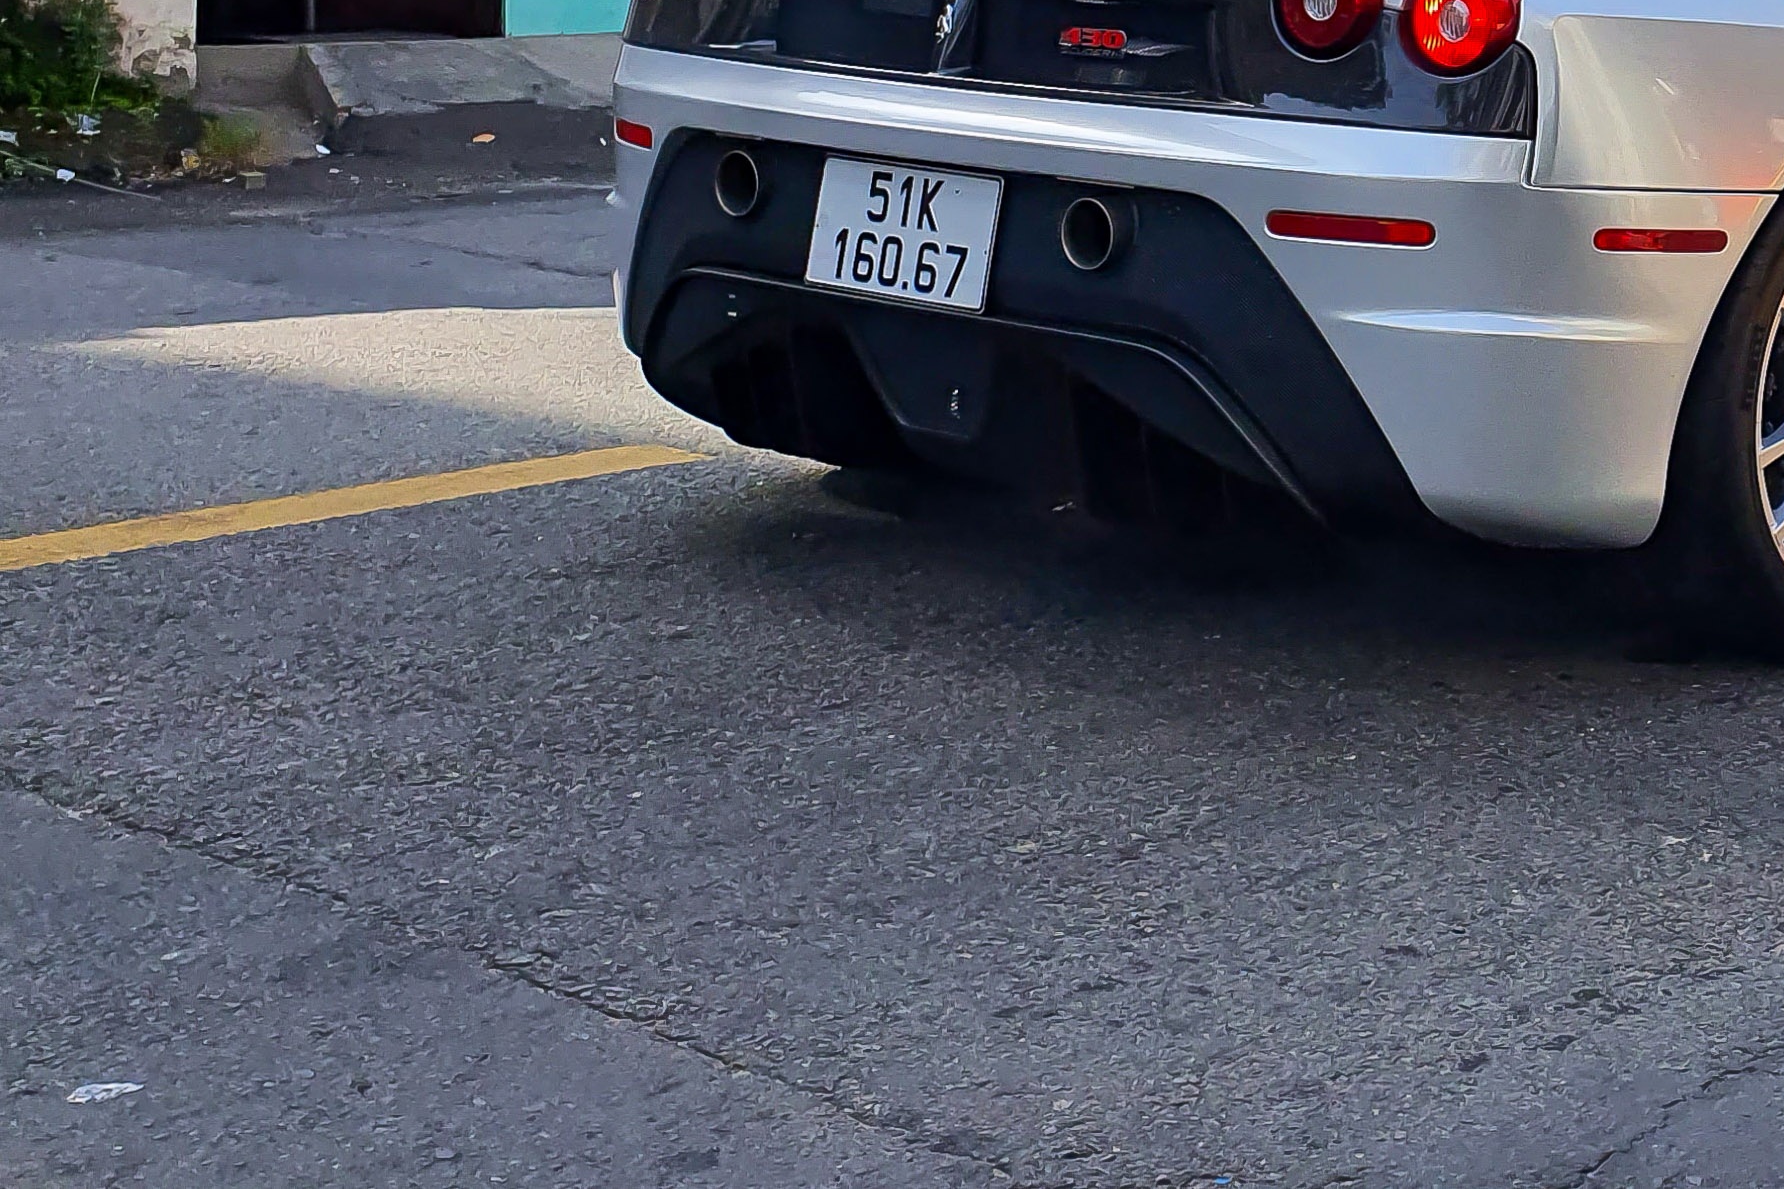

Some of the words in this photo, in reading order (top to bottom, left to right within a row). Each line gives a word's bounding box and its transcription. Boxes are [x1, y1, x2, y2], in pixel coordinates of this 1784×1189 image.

[1058, 26, 1128, 50] 430
[866, 170, 946, 233] 51K
[834, 227, 970, 299] 160.67
